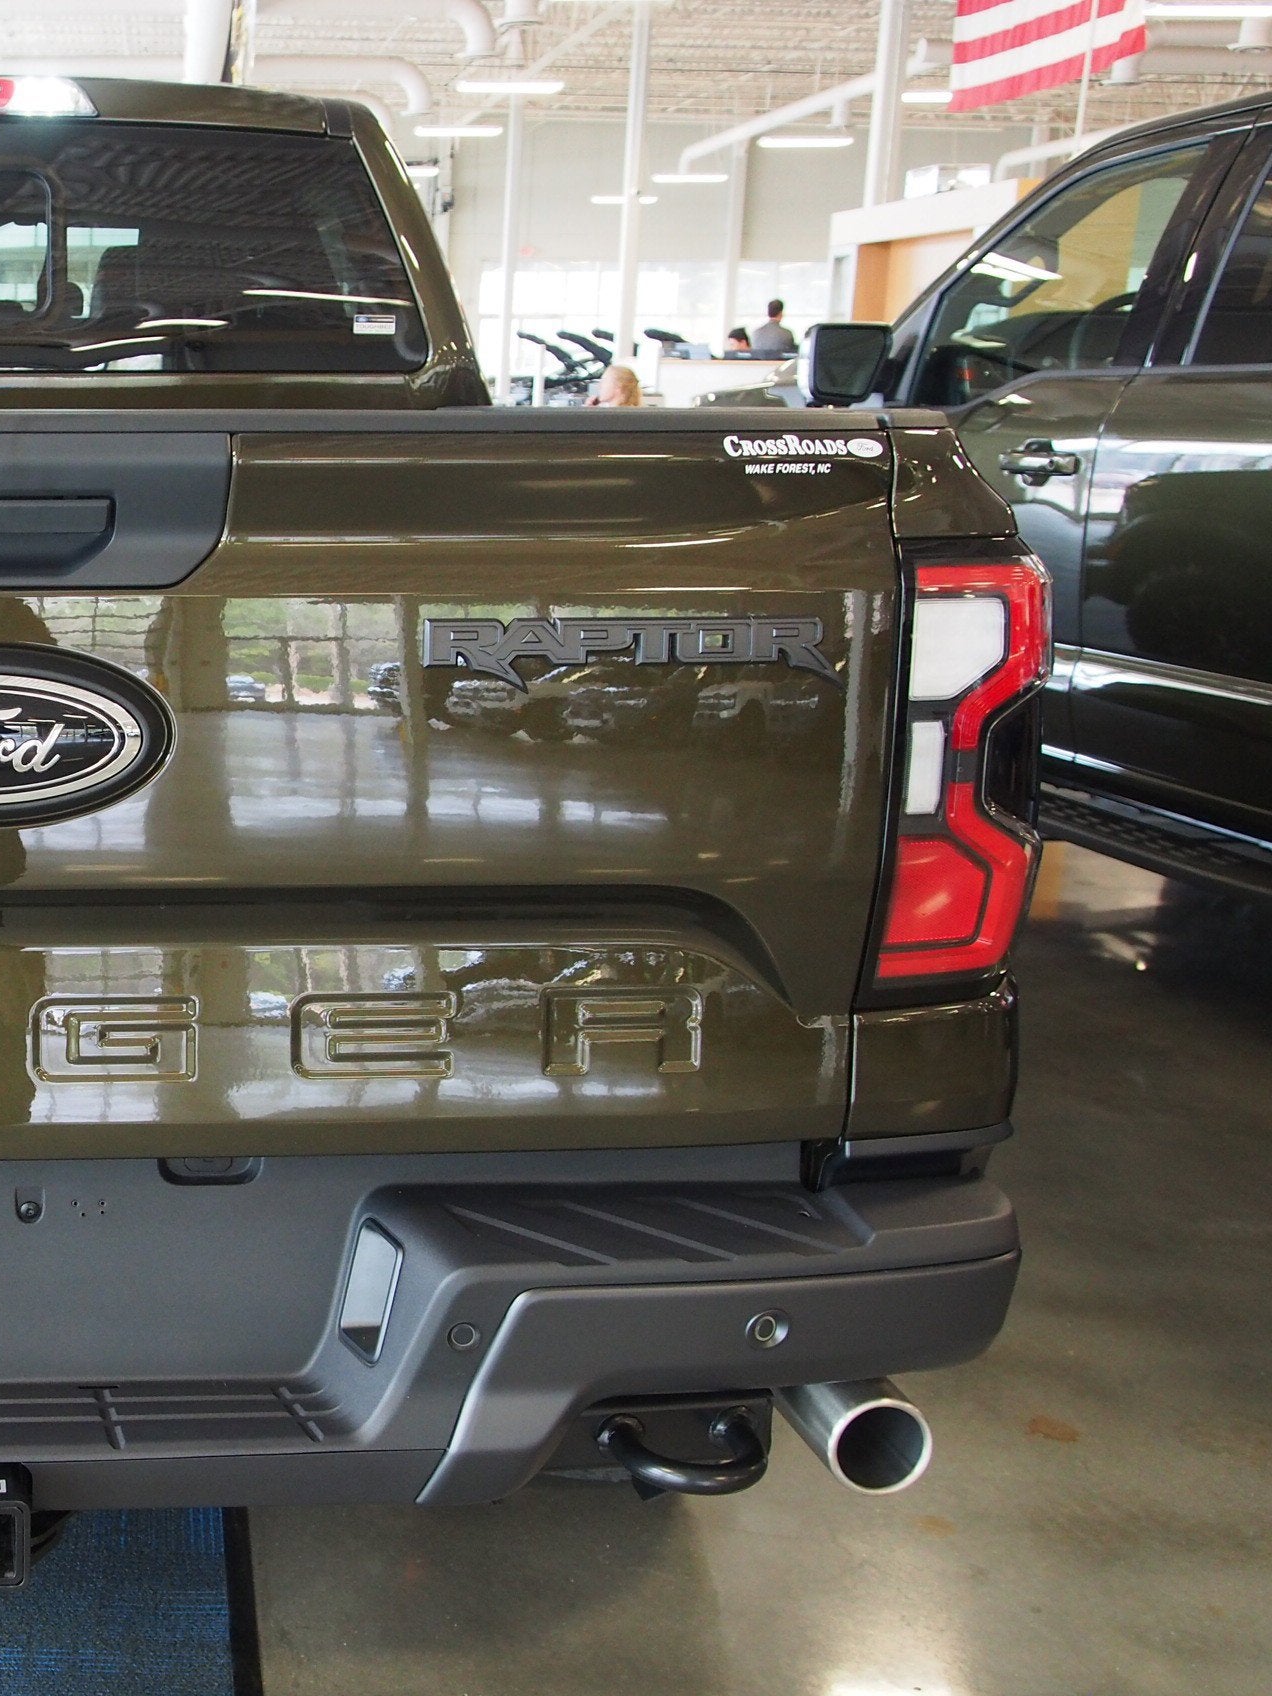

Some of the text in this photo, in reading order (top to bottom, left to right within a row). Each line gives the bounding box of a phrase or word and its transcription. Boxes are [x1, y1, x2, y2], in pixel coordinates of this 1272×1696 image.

[745, 463, 831, 476] WAKE FOREST, NC
[422, 617, 846, 694] RAPTOR
